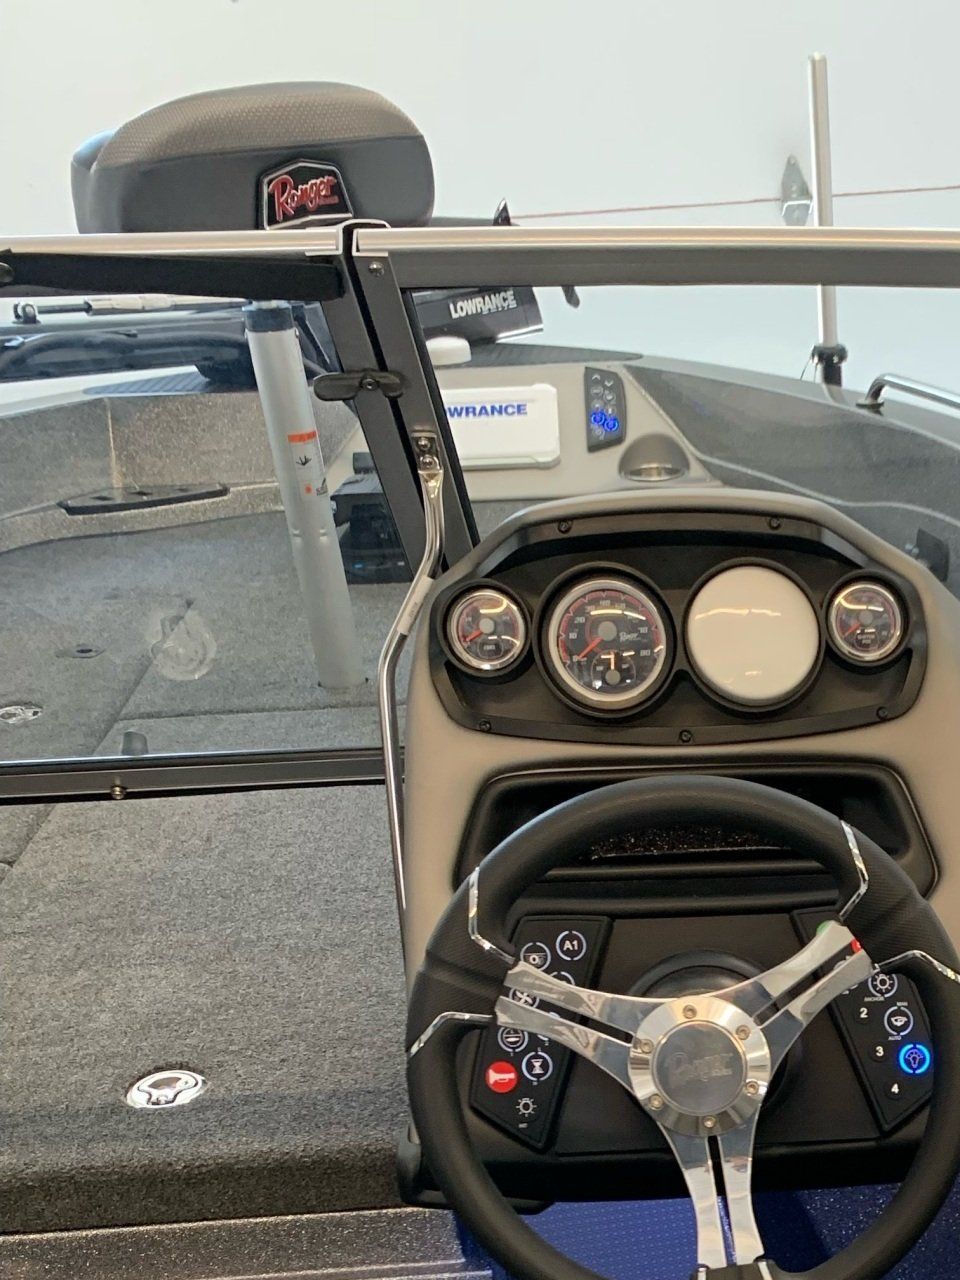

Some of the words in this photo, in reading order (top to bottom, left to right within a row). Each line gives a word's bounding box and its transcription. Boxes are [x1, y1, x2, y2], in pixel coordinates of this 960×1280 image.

[268, 174, 337, 221] Ranger
[449, 290, 516, 319] LOWRANCE
[444, 403, 528, 419] WRANCE
[563, 940, 579, 951] A1
[859, 1007, 869, 1018] 2
[875, 1046, 885, 1057] 3
[891, 1083, 900, 1094] 4
